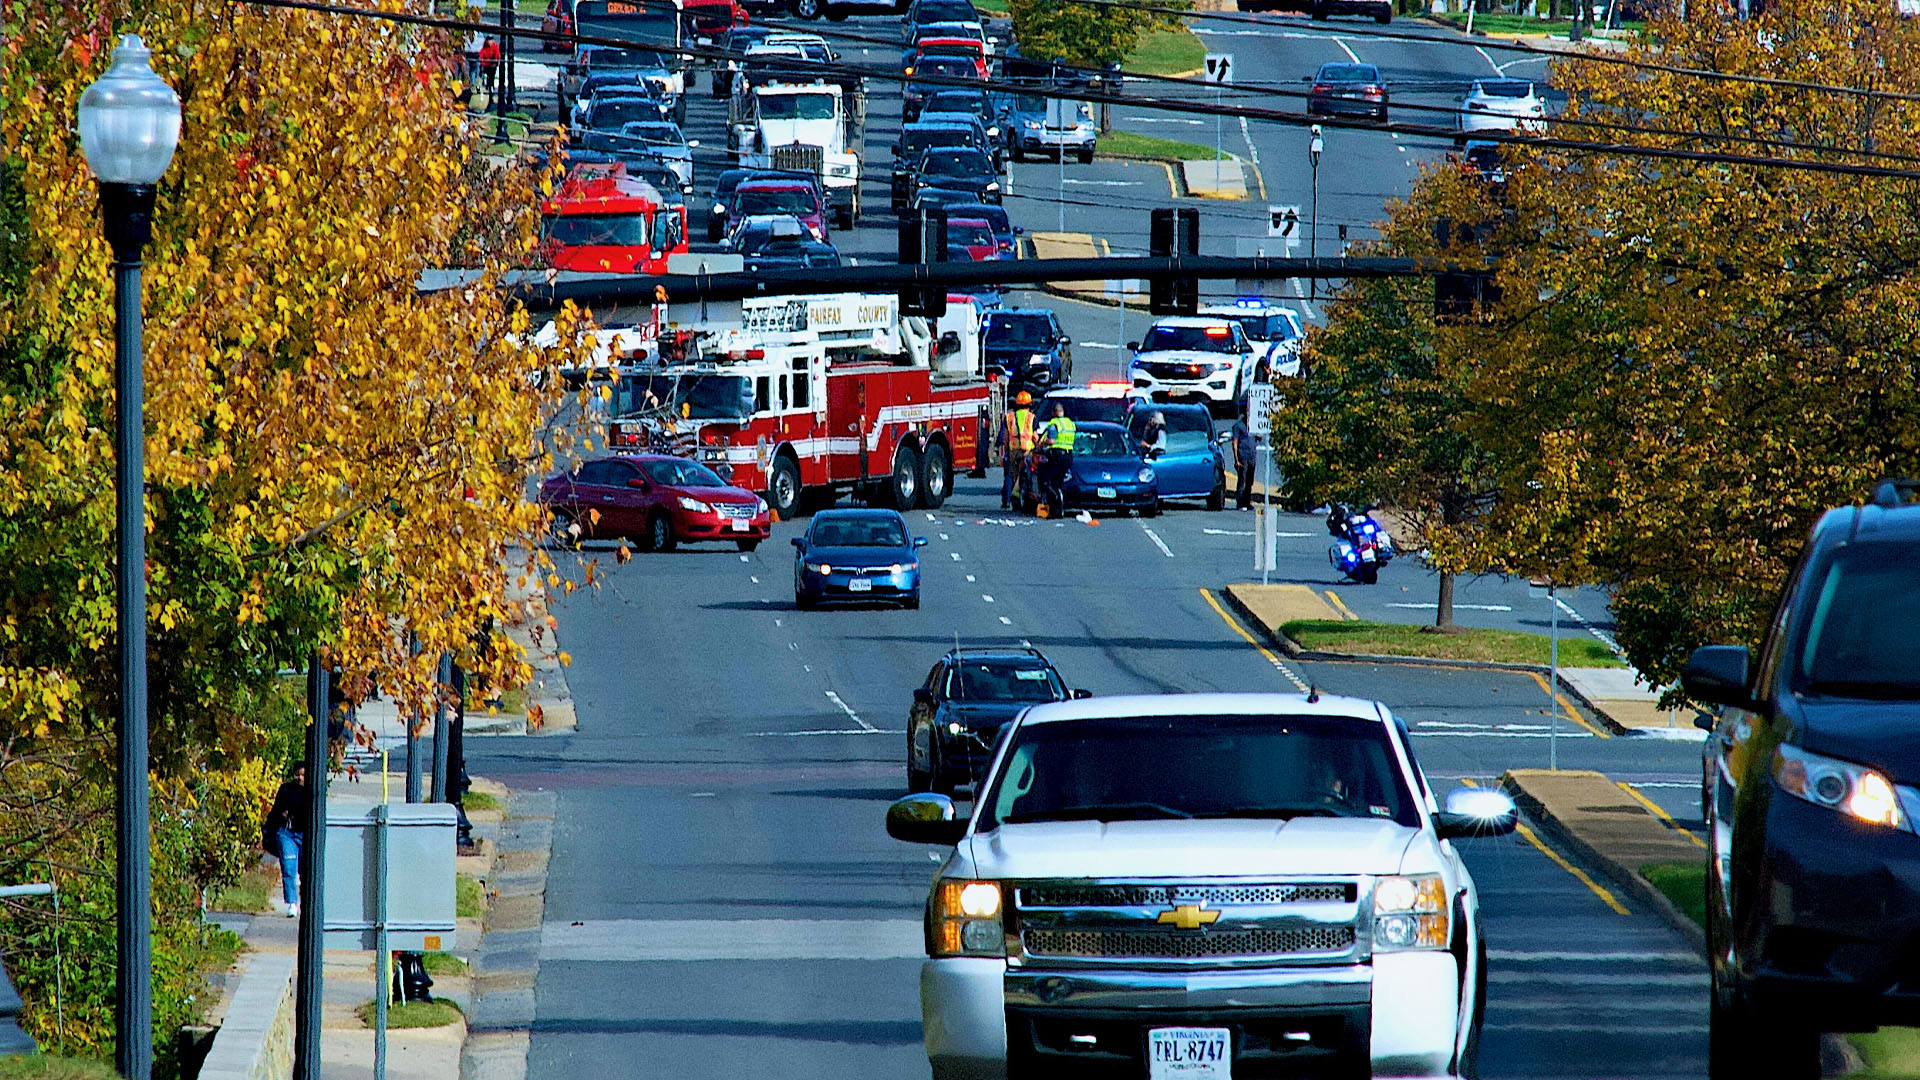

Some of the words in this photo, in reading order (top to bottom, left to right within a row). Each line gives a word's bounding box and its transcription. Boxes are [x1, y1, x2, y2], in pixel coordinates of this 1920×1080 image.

[810, 307, 841, 324] FAIRFAX
[858, 306, 888, 323] COUNTY
[1250, 389, 1267, 398] LEFT
[1169, 1031, 1210, 1039] VIRGINIA
